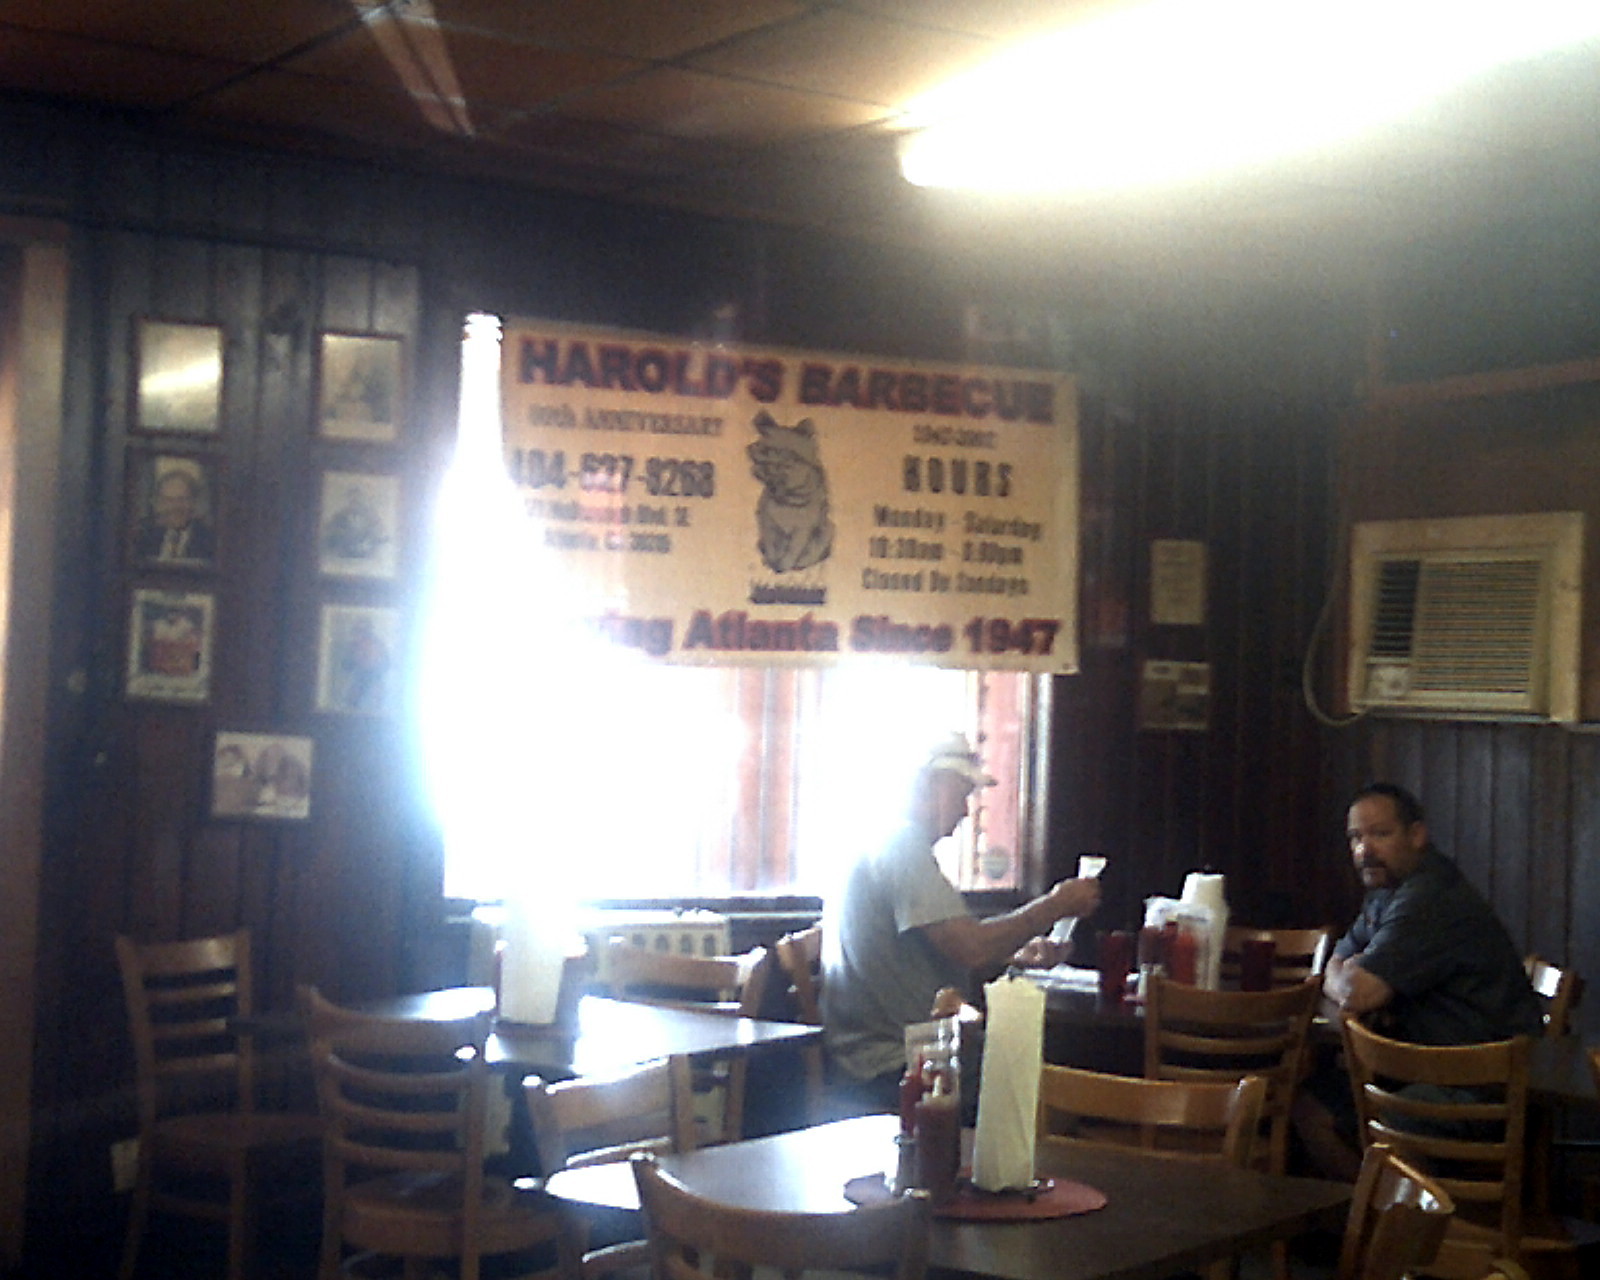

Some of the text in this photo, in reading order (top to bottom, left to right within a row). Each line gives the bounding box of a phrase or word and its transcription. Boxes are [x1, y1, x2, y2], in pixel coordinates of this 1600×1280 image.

[518, 335, 1055, 425] HAROLD'S BARBECUE
[682, 609, 839, 651] Atlanta
[850, 615, 952, 651] Since
[964, 616, 1062, 656] 1947
